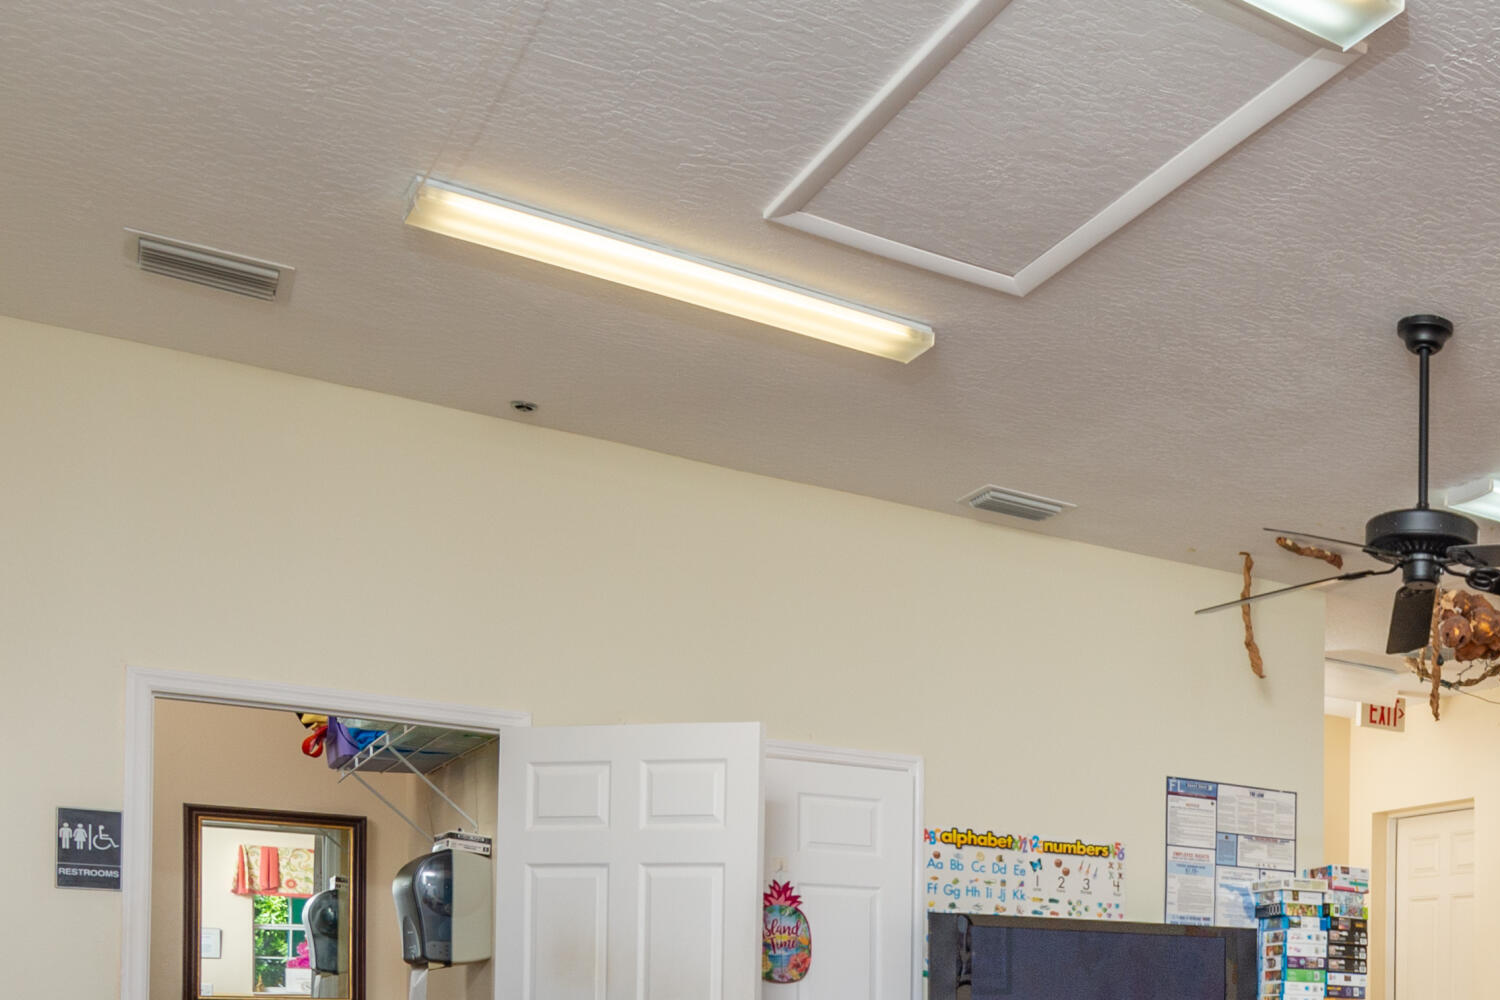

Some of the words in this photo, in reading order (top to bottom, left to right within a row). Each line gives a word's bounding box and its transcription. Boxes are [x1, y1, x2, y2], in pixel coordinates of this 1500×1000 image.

[940, 827, 1015, 849] alphabet
[1042, 839, 1110, 858] numbers
[58, 867, 119, 878] RESTROOMS
[927, 858, 944, 870] Aa
[950, 858, 964, 871] Bb
[971, 860, 986, 873] Cc
[992, 862, 1007, 875] Dd
[1013, 864, 1026, 876] Ee
[927, 882, 938, 895] Ff
[943, 883, 960, 900] Gg
[965, 886, 980, 897] Hh
[1012, 889, 1025, 901] Kk
[1058, 876, 1065, 889] 2
[1083, 878, 1090, 891] 3
[1112, 880, 1121, 892] 4
